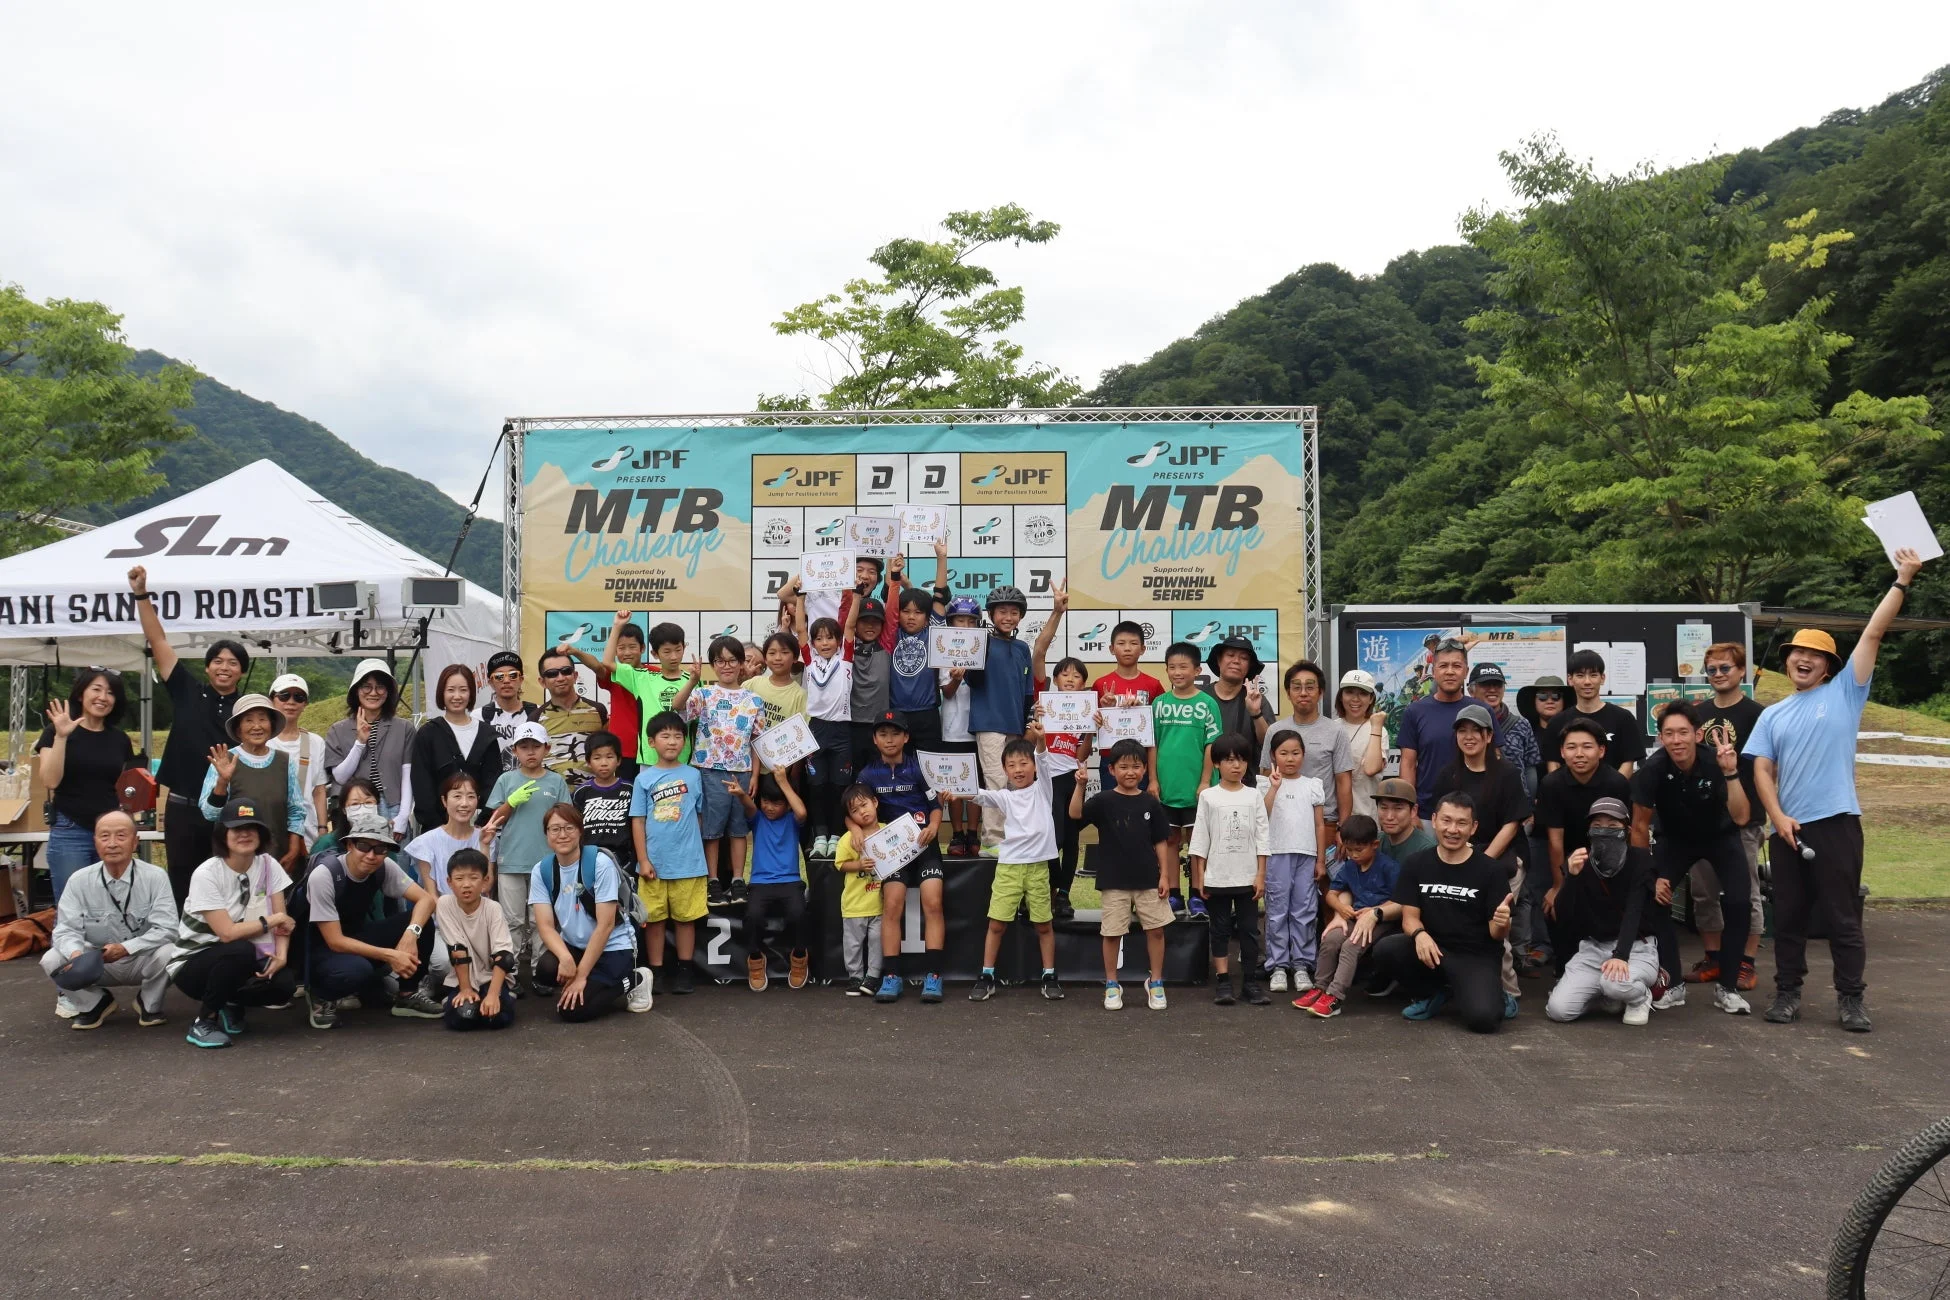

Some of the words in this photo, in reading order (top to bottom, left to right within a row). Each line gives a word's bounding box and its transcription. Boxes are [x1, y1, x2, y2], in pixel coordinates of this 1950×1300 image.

[632, 450, 690, 470] JPF
[1168, 446, 1228, 466] JPF
[616, 475, 667, 483] PRESENTS
[796, 471, 844, 487] JPF
[1004, 468, 1053, 485] JPF
[1153, 472, 1205, 480] PRESENTS
[564, 487, 724, 535] MTB
[1100, 484, 1264, 531] MTB
[816, 537, 843, 546] JPF
[973, 535, 1001, 545] JPF
[565, 524, 726, 583] Challenge
[1101, 521, 1265, 581] Challenge
[615, 568, 655, 576] Supported
[656, 568, 666, 576] by
[1153, 566, 1193, 574] Supported
[1195, 566, 1205, 574] by
[604, 578, 678, 590] DOWNHILL
[954, 573, 1004, 590] JPF
[1142, 576, 1217, 588] DOWNHILL
[614, 590, 665, 603] SERIES
[1152, 588, 1205, 601] SERIES
[194, 586, 364, 620] ROAST
[1219, 625, 1267, 641] JPF
[1488, 632, 1515, 641] MTB
[1079, 642, 1106, 652] JPF
[1361, 634, 1392, 663] 遊
[763, 700, 783, 713] NDAY
[652, 790, 665, 802] JUST
[664, 788, 673, 797] DO
[583, 796, 620, 815] FAST
[582, 808, 628, 825] HOUSE
[1418, 883, 1480, 899] TREK
[900, 886, 926, 954] 1
[706, 918, 732, 965] 2
